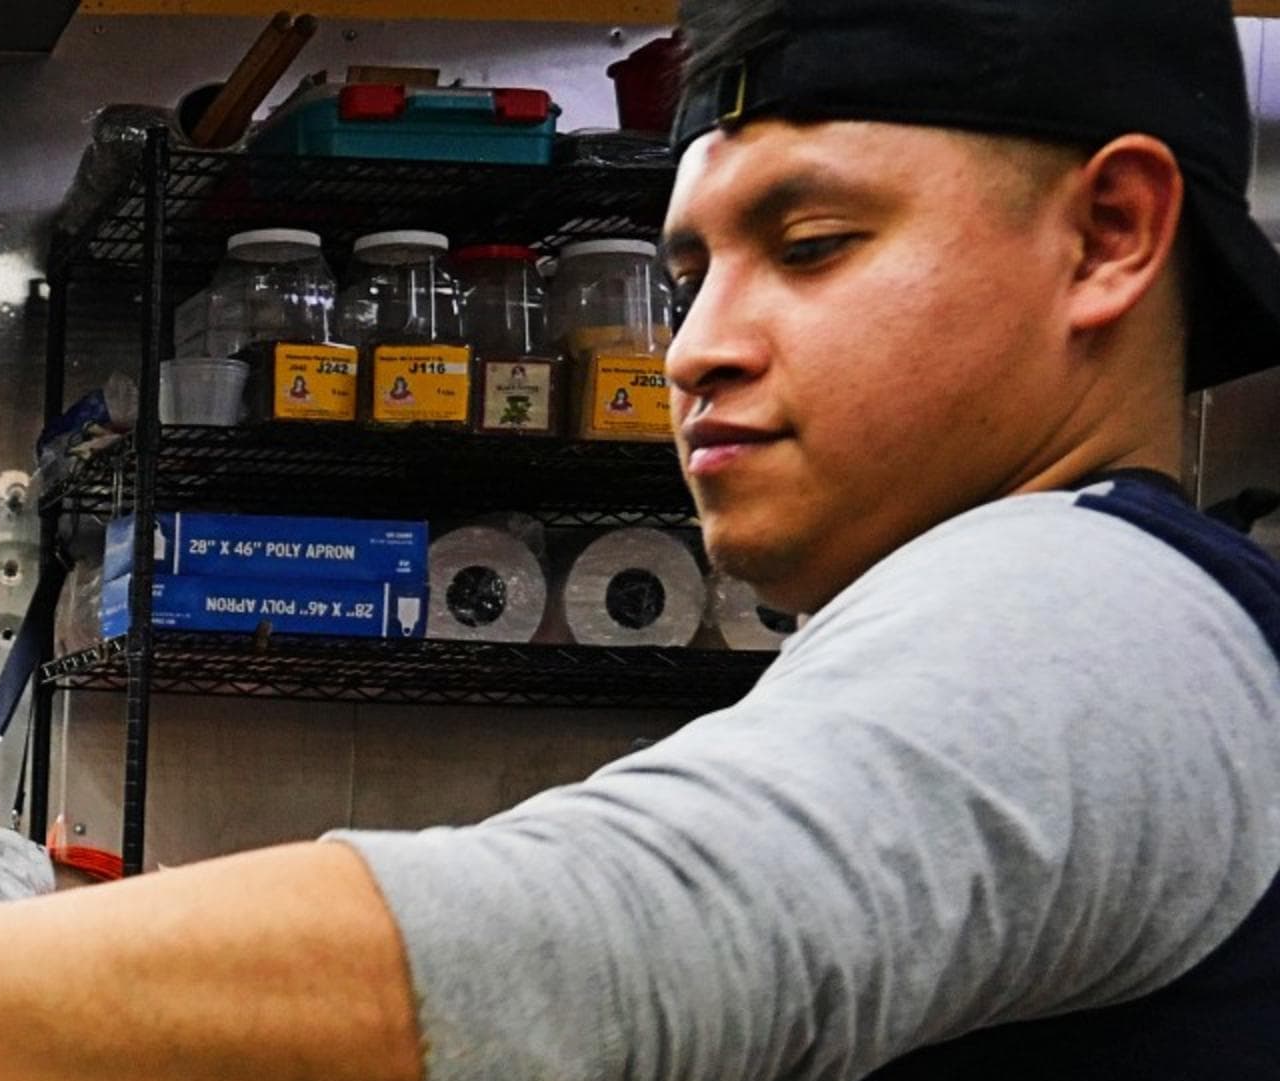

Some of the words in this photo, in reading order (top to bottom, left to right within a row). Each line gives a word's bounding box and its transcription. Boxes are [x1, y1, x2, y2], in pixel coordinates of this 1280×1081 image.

[316, 361, 349, 374] J242
[408, 362, 446, 375] J116
[189, 539, 215, 555] 28"
[219, 541, 230, 555] X
[234, 542, 262, 557] 46"
[265, 542, 301, 557] POLY
[305, 544, 355, 560] APRON
[206, 597, 256, 613] APRON
[260, 599, 296, 615] POLY
[300, 601, 328, 616] 46"
[332, 602, 342, 617] X
[346, 603, 374, 619] 28"
